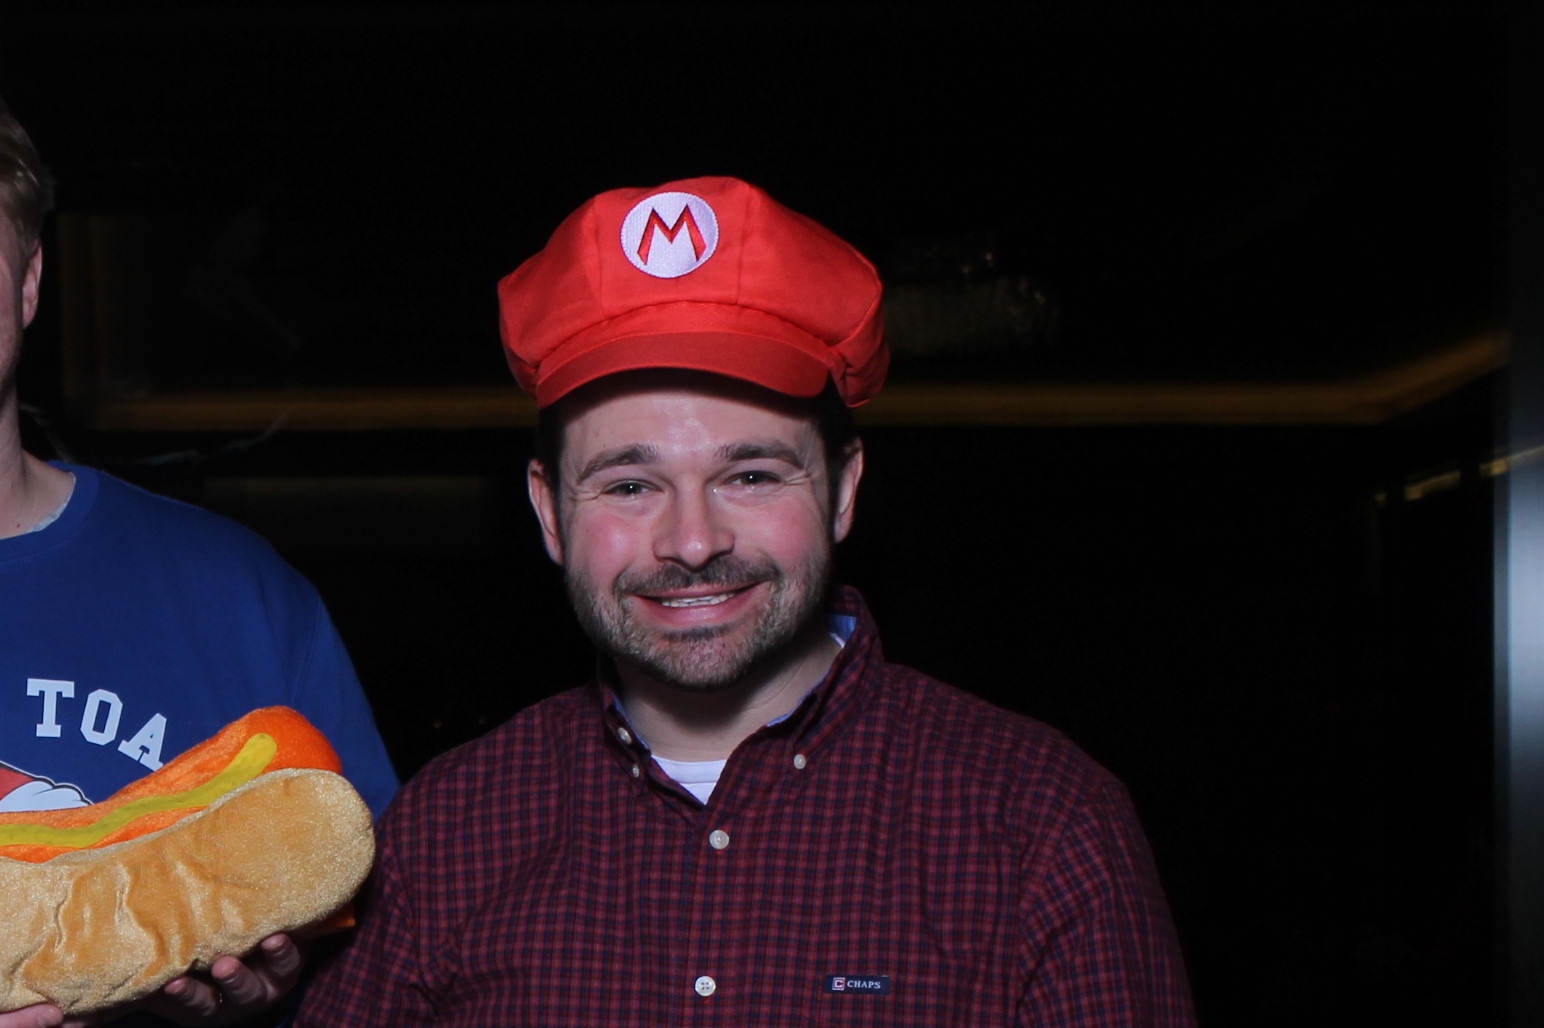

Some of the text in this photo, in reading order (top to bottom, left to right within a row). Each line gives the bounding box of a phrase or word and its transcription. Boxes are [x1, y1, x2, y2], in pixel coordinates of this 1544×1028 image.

[637, 203, 707, 266] M
[26, 678, 168, 772] TOA
[846, 980, 881, 989] CHAPS
